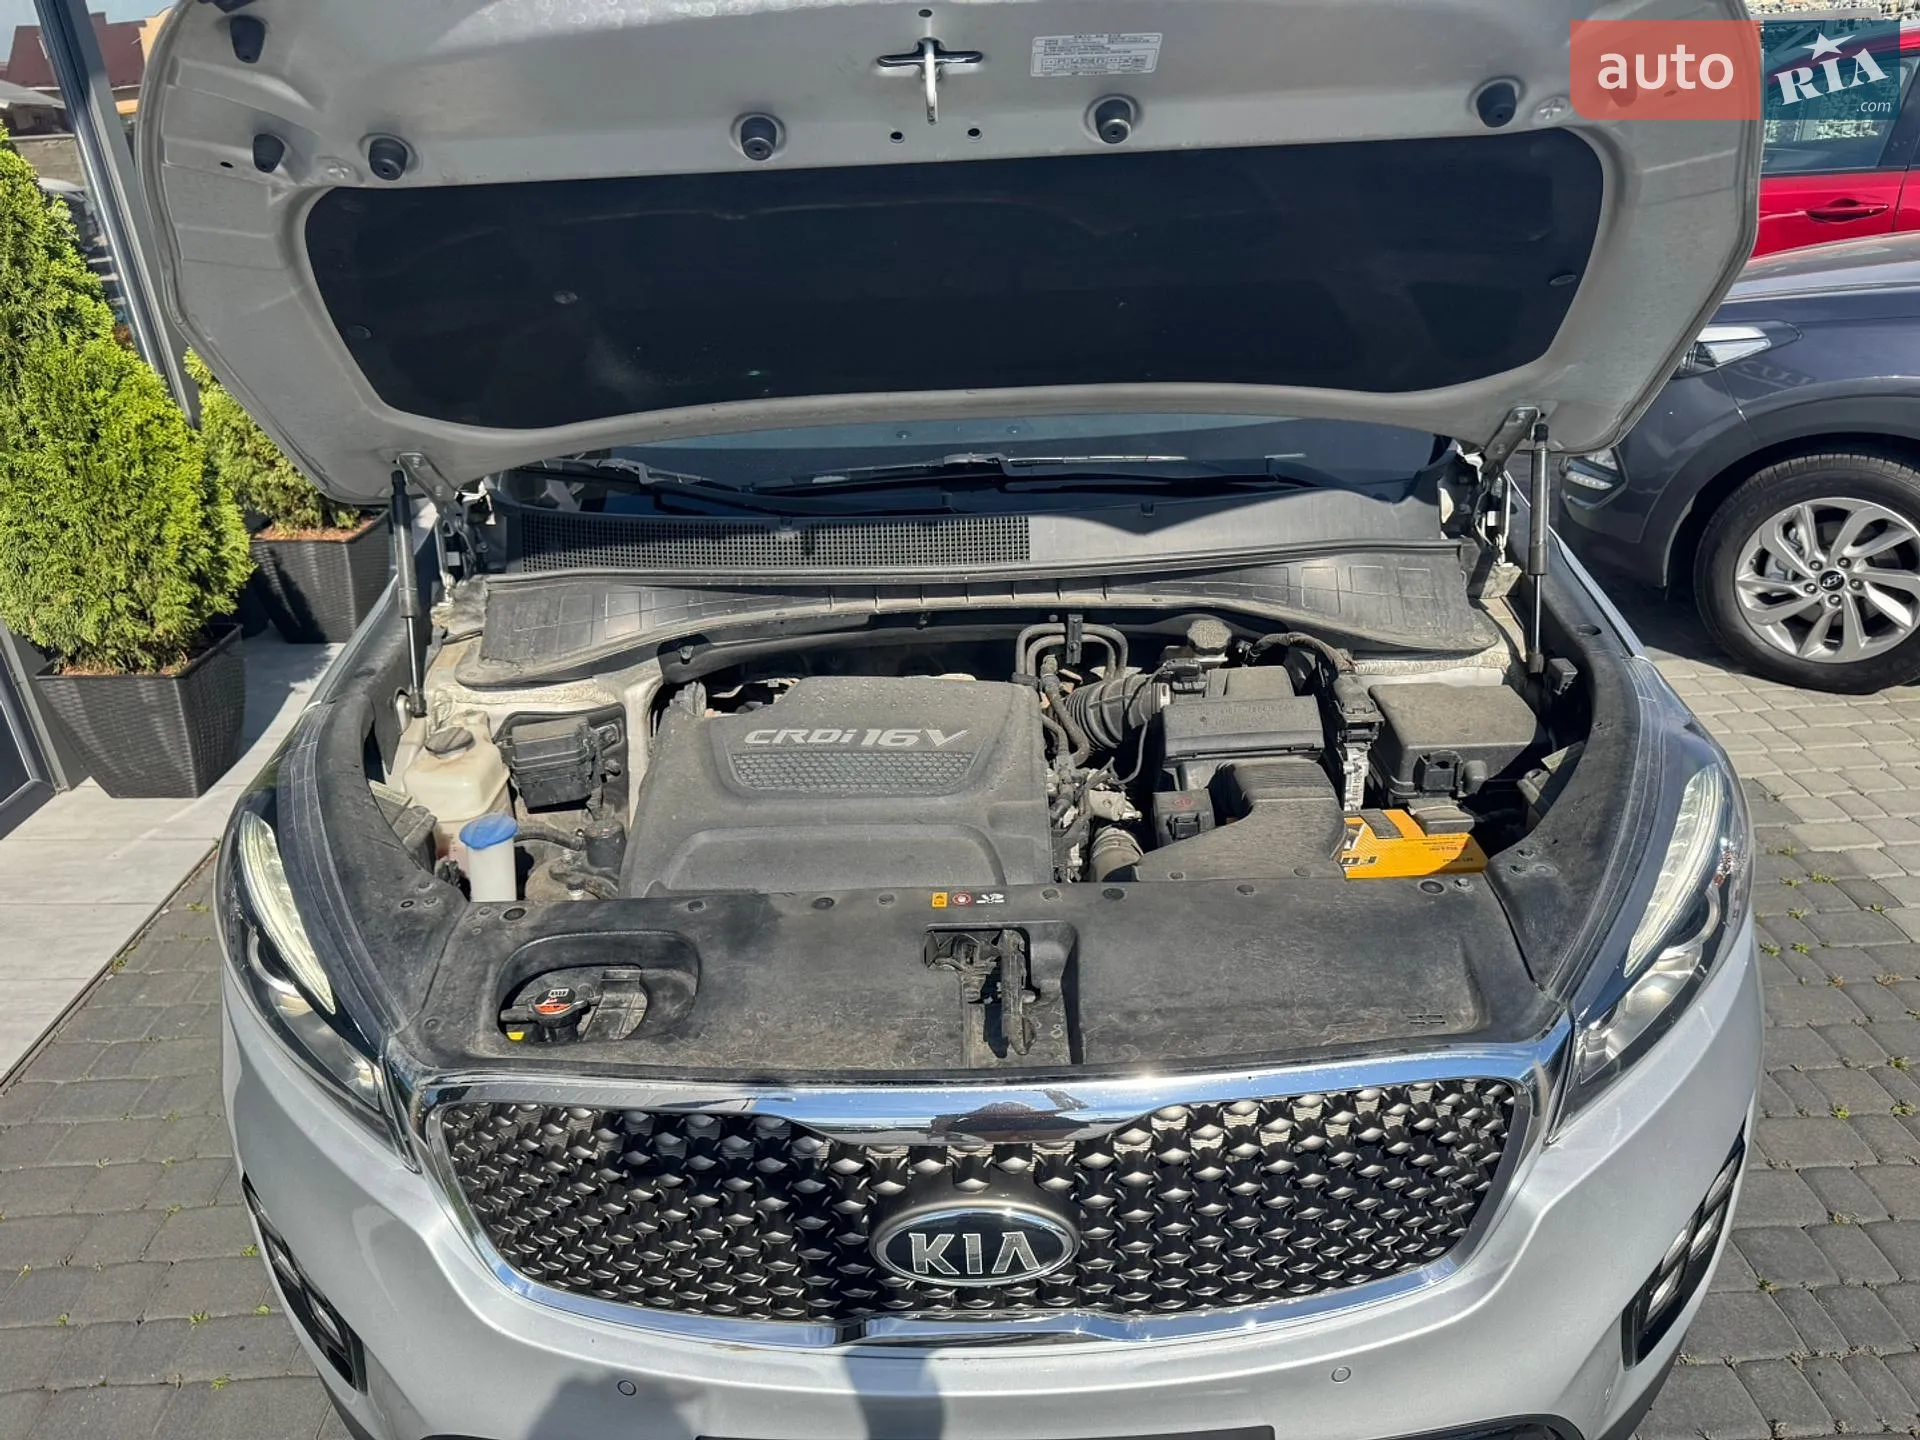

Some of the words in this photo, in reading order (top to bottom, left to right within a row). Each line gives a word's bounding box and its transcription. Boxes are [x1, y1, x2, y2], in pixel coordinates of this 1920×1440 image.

[744, 728, 857, 744] CRDi
[860, 728, 971, 747] 16V
[909, 1231, 1041, 1275] KIA
